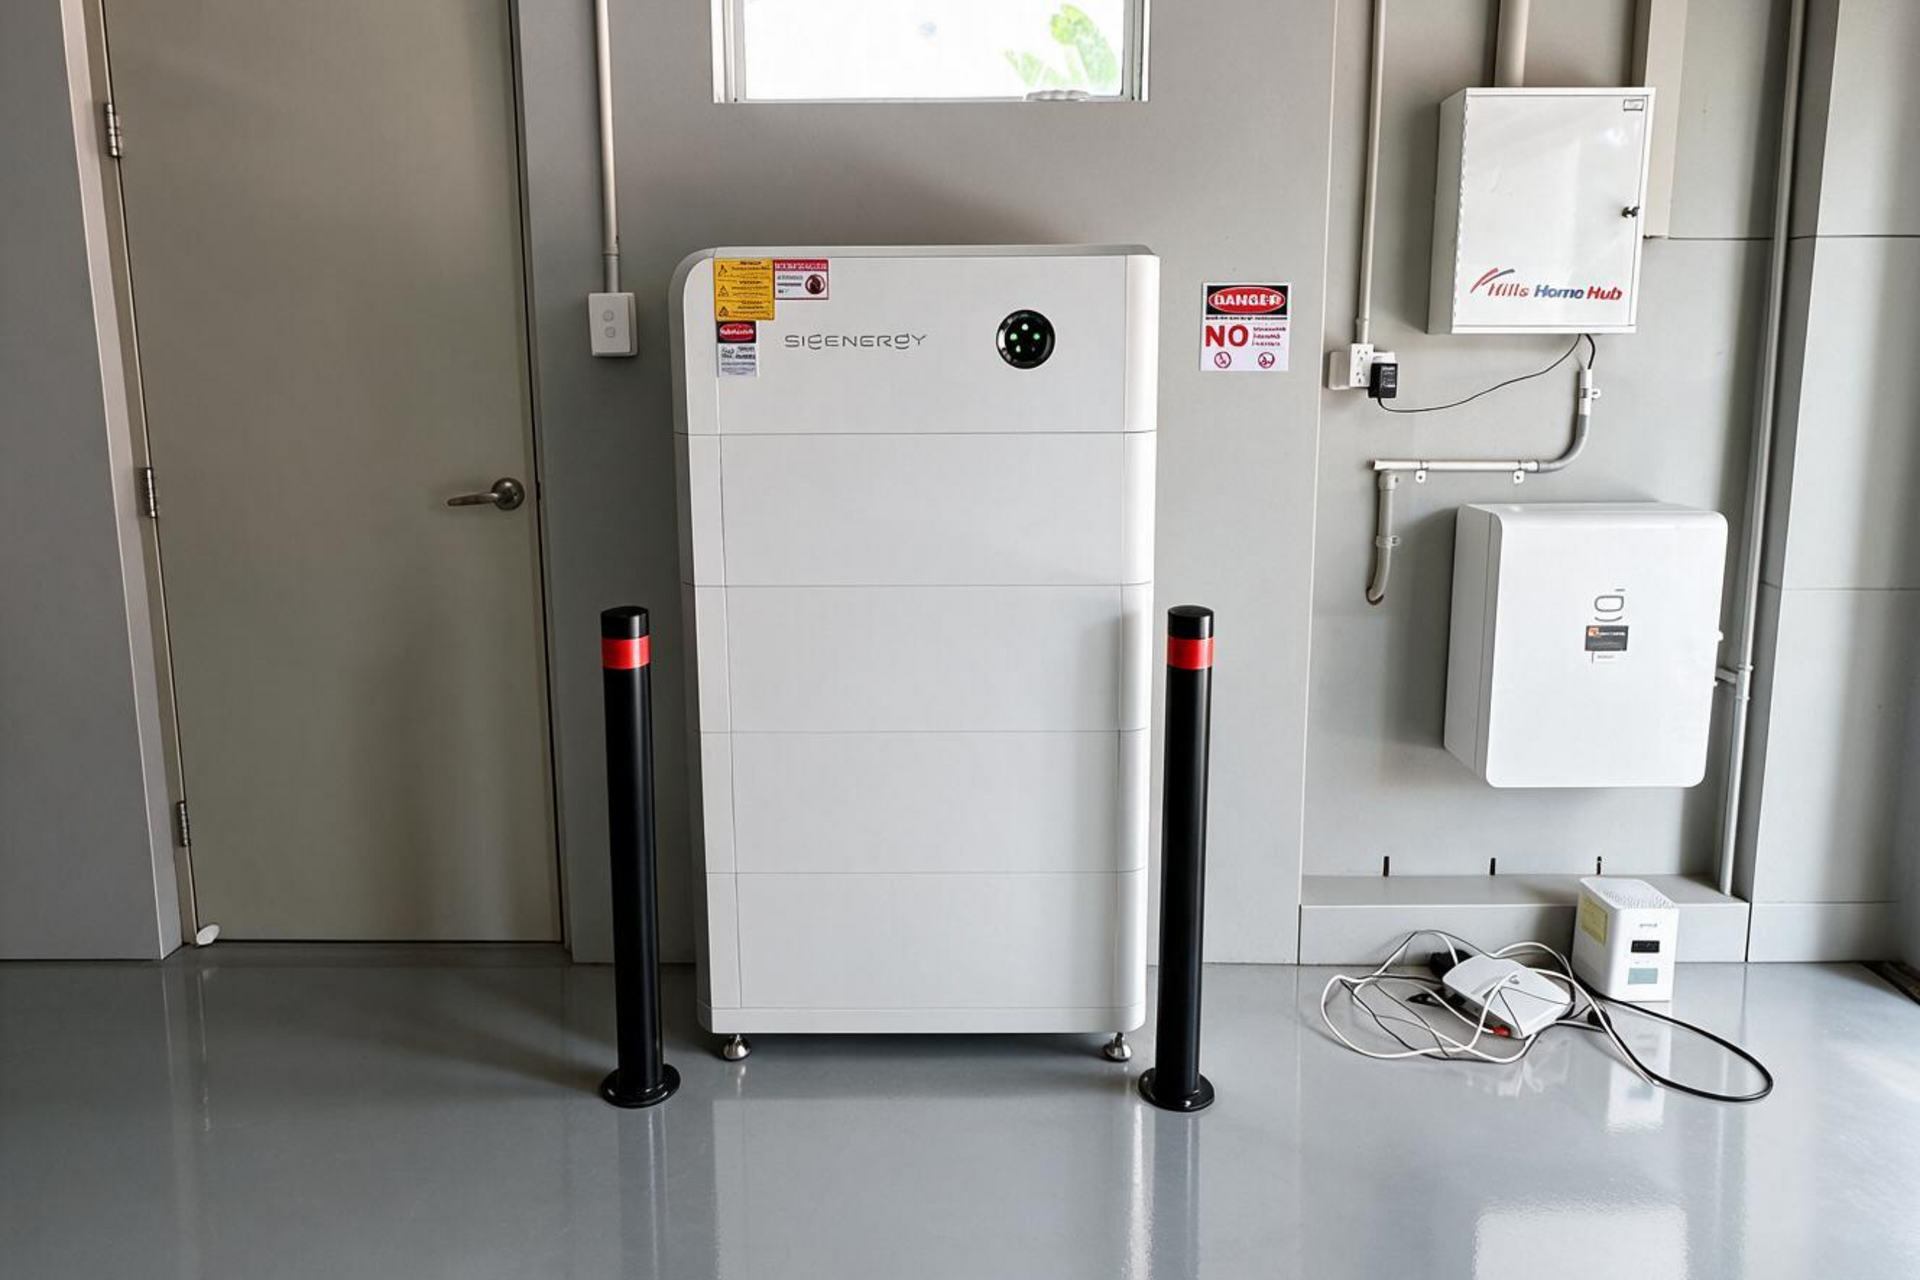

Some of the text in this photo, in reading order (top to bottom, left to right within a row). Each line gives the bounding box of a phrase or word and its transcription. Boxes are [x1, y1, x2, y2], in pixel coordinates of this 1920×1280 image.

[1214, 293, 1282, 306] DANGER
[1488, 282, 1529, 298] Hills
[1587, 285, 1623, 301] Hub
[1205, 324, 1249, 348] NO
